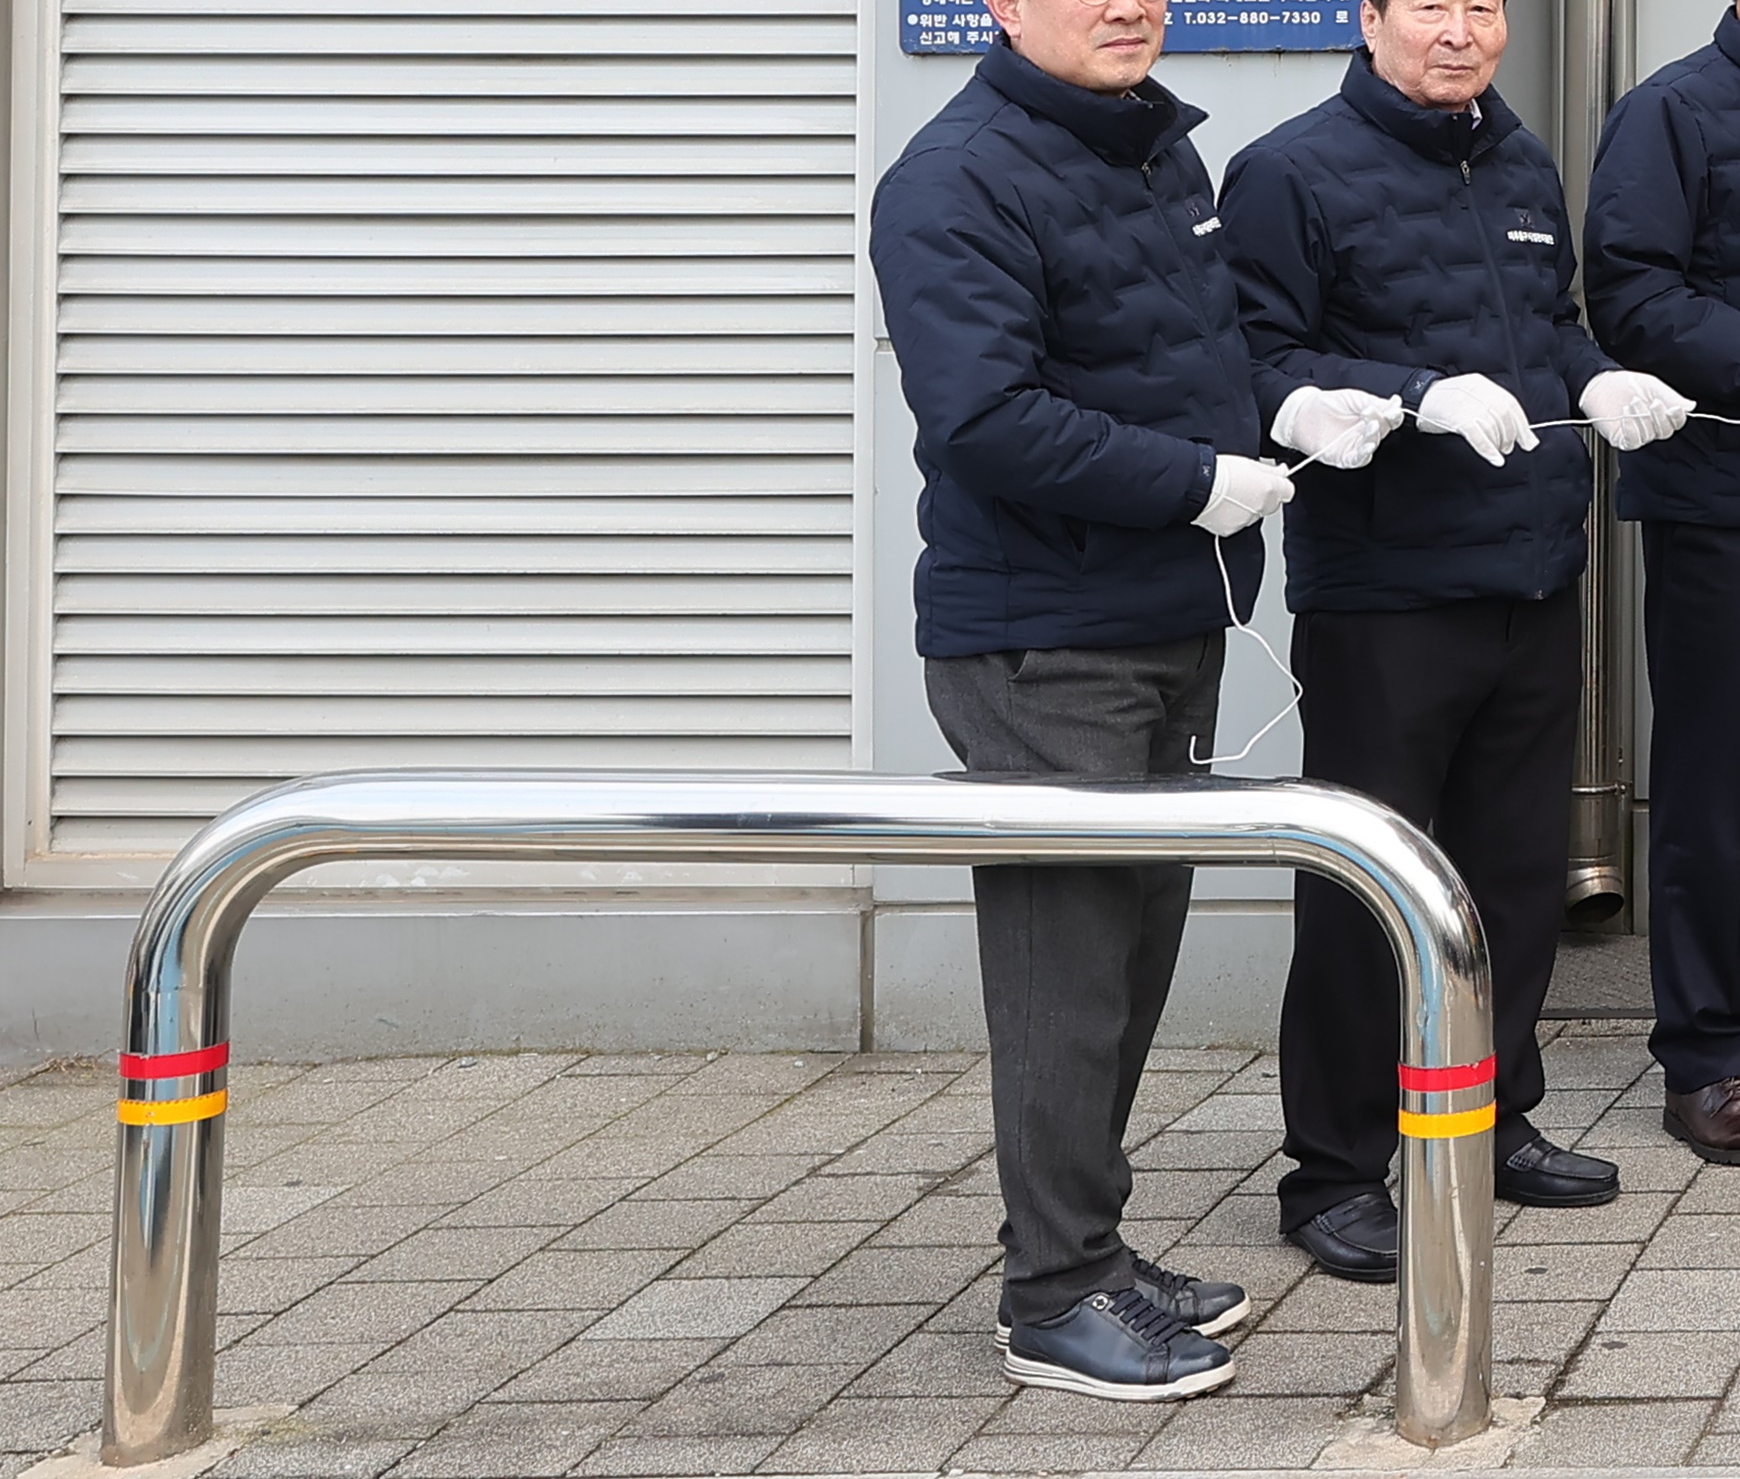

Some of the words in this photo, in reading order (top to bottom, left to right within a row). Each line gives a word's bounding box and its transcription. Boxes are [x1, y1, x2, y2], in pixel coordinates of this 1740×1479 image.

[920, 14, 947, 27] 위반
[952, 13, 993, 27] 사항을
[1335, 11, 1349, 24] 로
[920, 32, 960, 45] 신고해
[966, 31, 999, 45] 주시
